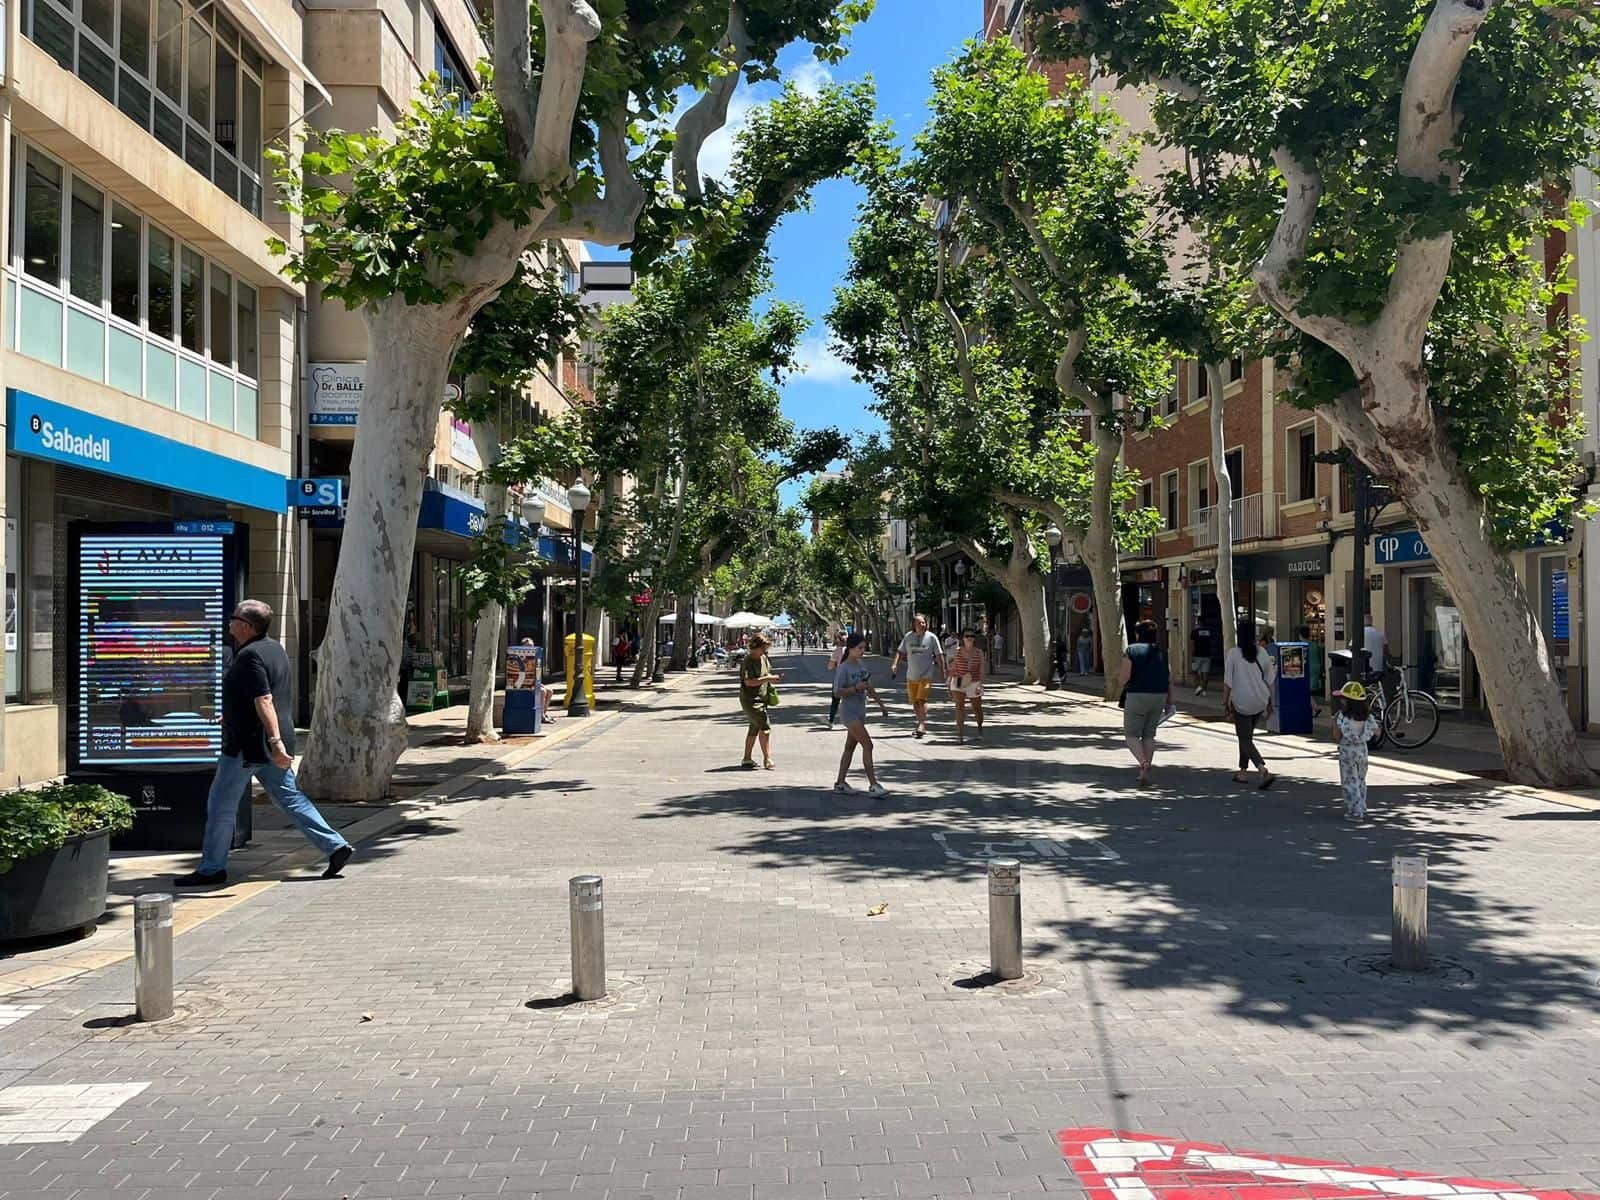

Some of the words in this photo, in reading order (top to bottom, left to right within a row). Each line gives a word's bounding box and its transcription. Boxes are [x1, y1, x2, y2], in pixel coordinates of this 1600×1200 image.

[321, 382, 335, 391] Dr.
[41, 421, 110, 463] Sabadell
[304, 483, 313, 493] B
[318, 483, 336, 505] S
